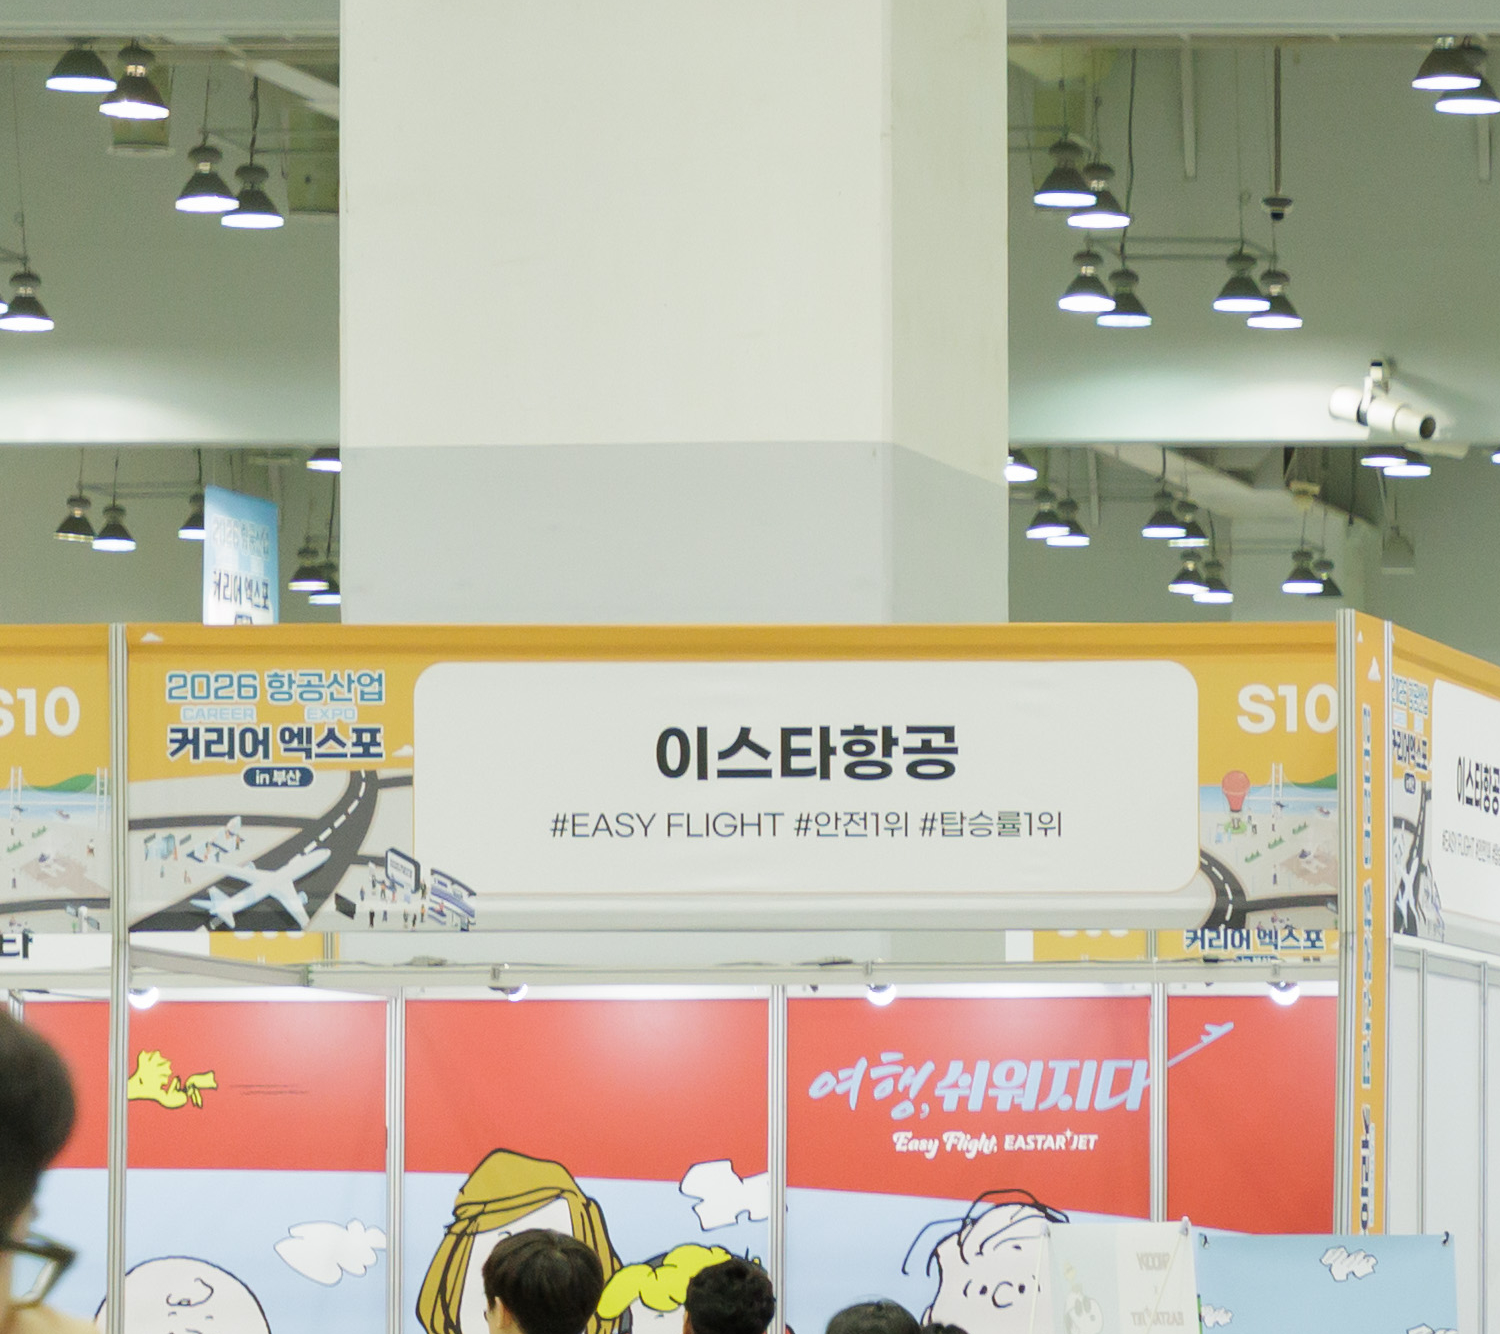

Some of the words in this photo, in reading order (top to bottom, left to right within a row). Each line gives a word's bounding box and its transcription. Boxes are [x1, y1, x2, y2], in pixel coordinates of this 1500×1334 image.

[166, 672, 259, 702] 2026
[267, 671, 384, 703] 항공산업
[182, 706, 255, 721] CAREER
[306, 706, 356, 721] EXPO
[1236, 683, 1338, 734] S10
[168, 726, 270, 760] 커리어
[279, 726, 384, 760] 엑스포
[656, 725, 959, 781] 이스타항공
[255, 770, 270, 785] in
[272, 769, 301, 786] 부산
[1457, 756, 1500, 816] 이스타항공
[550, 811, 657, 838] #EASY
[667, 811, 784, 838] FLIGHT
[793, 810, 909, 838] #안전1위
[919, 810, 1063, 839] #탑승률1위
[1184, 929, 1251, 951] 커리어
[935, 1059, 1151, 1113] 쉬워지다
[892, 1130, 939, 1160] Easy
[1004, 1134, 1066, 1151] EASTAR
[1069, 1134, 1099, 1151] JET
